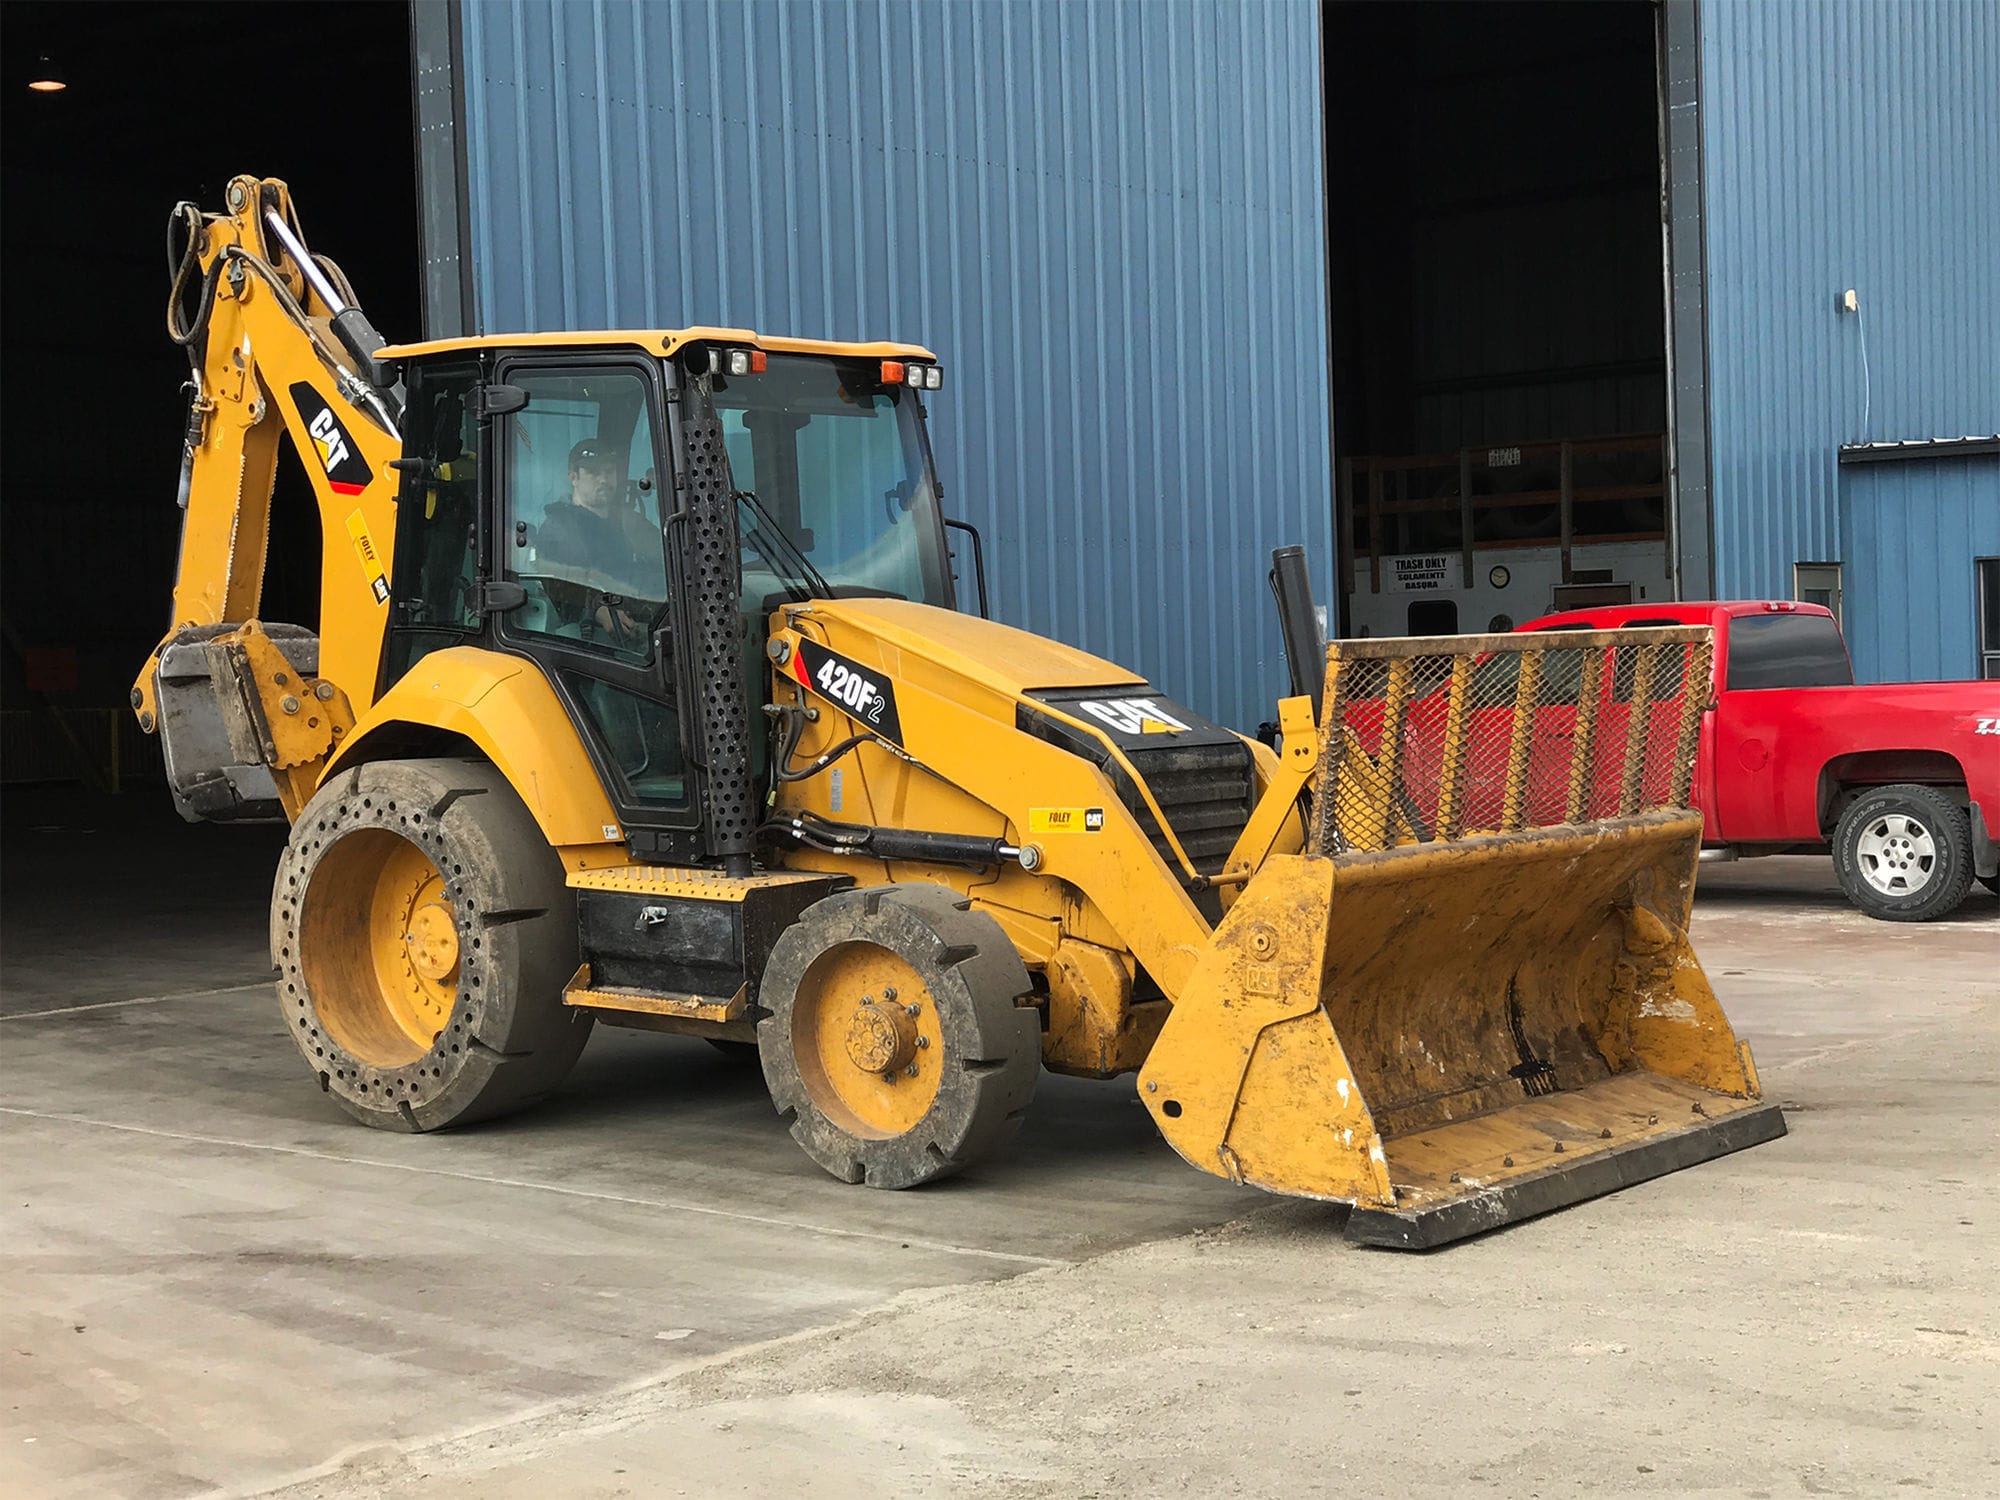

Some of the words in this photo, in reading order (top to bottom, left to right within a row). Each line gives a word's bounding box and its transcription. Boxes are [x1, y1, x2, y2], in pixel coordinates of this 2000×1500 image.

[310, 408, 350, 474] CAT
[360, 535, 375, 561] FOLEY
[1395, 559, 1424, 570] TRASH
[1425, 557, 1447, 569] ONLY
[1398, 572, 1445, 581] SOLAMENTE
[374, 578, 389, 600] CAT
[1079, 699, 1193, 735] CAT
[1048, 812, 1071, 823] FOLEY
[1086, 813, 1103, 827] CAT
